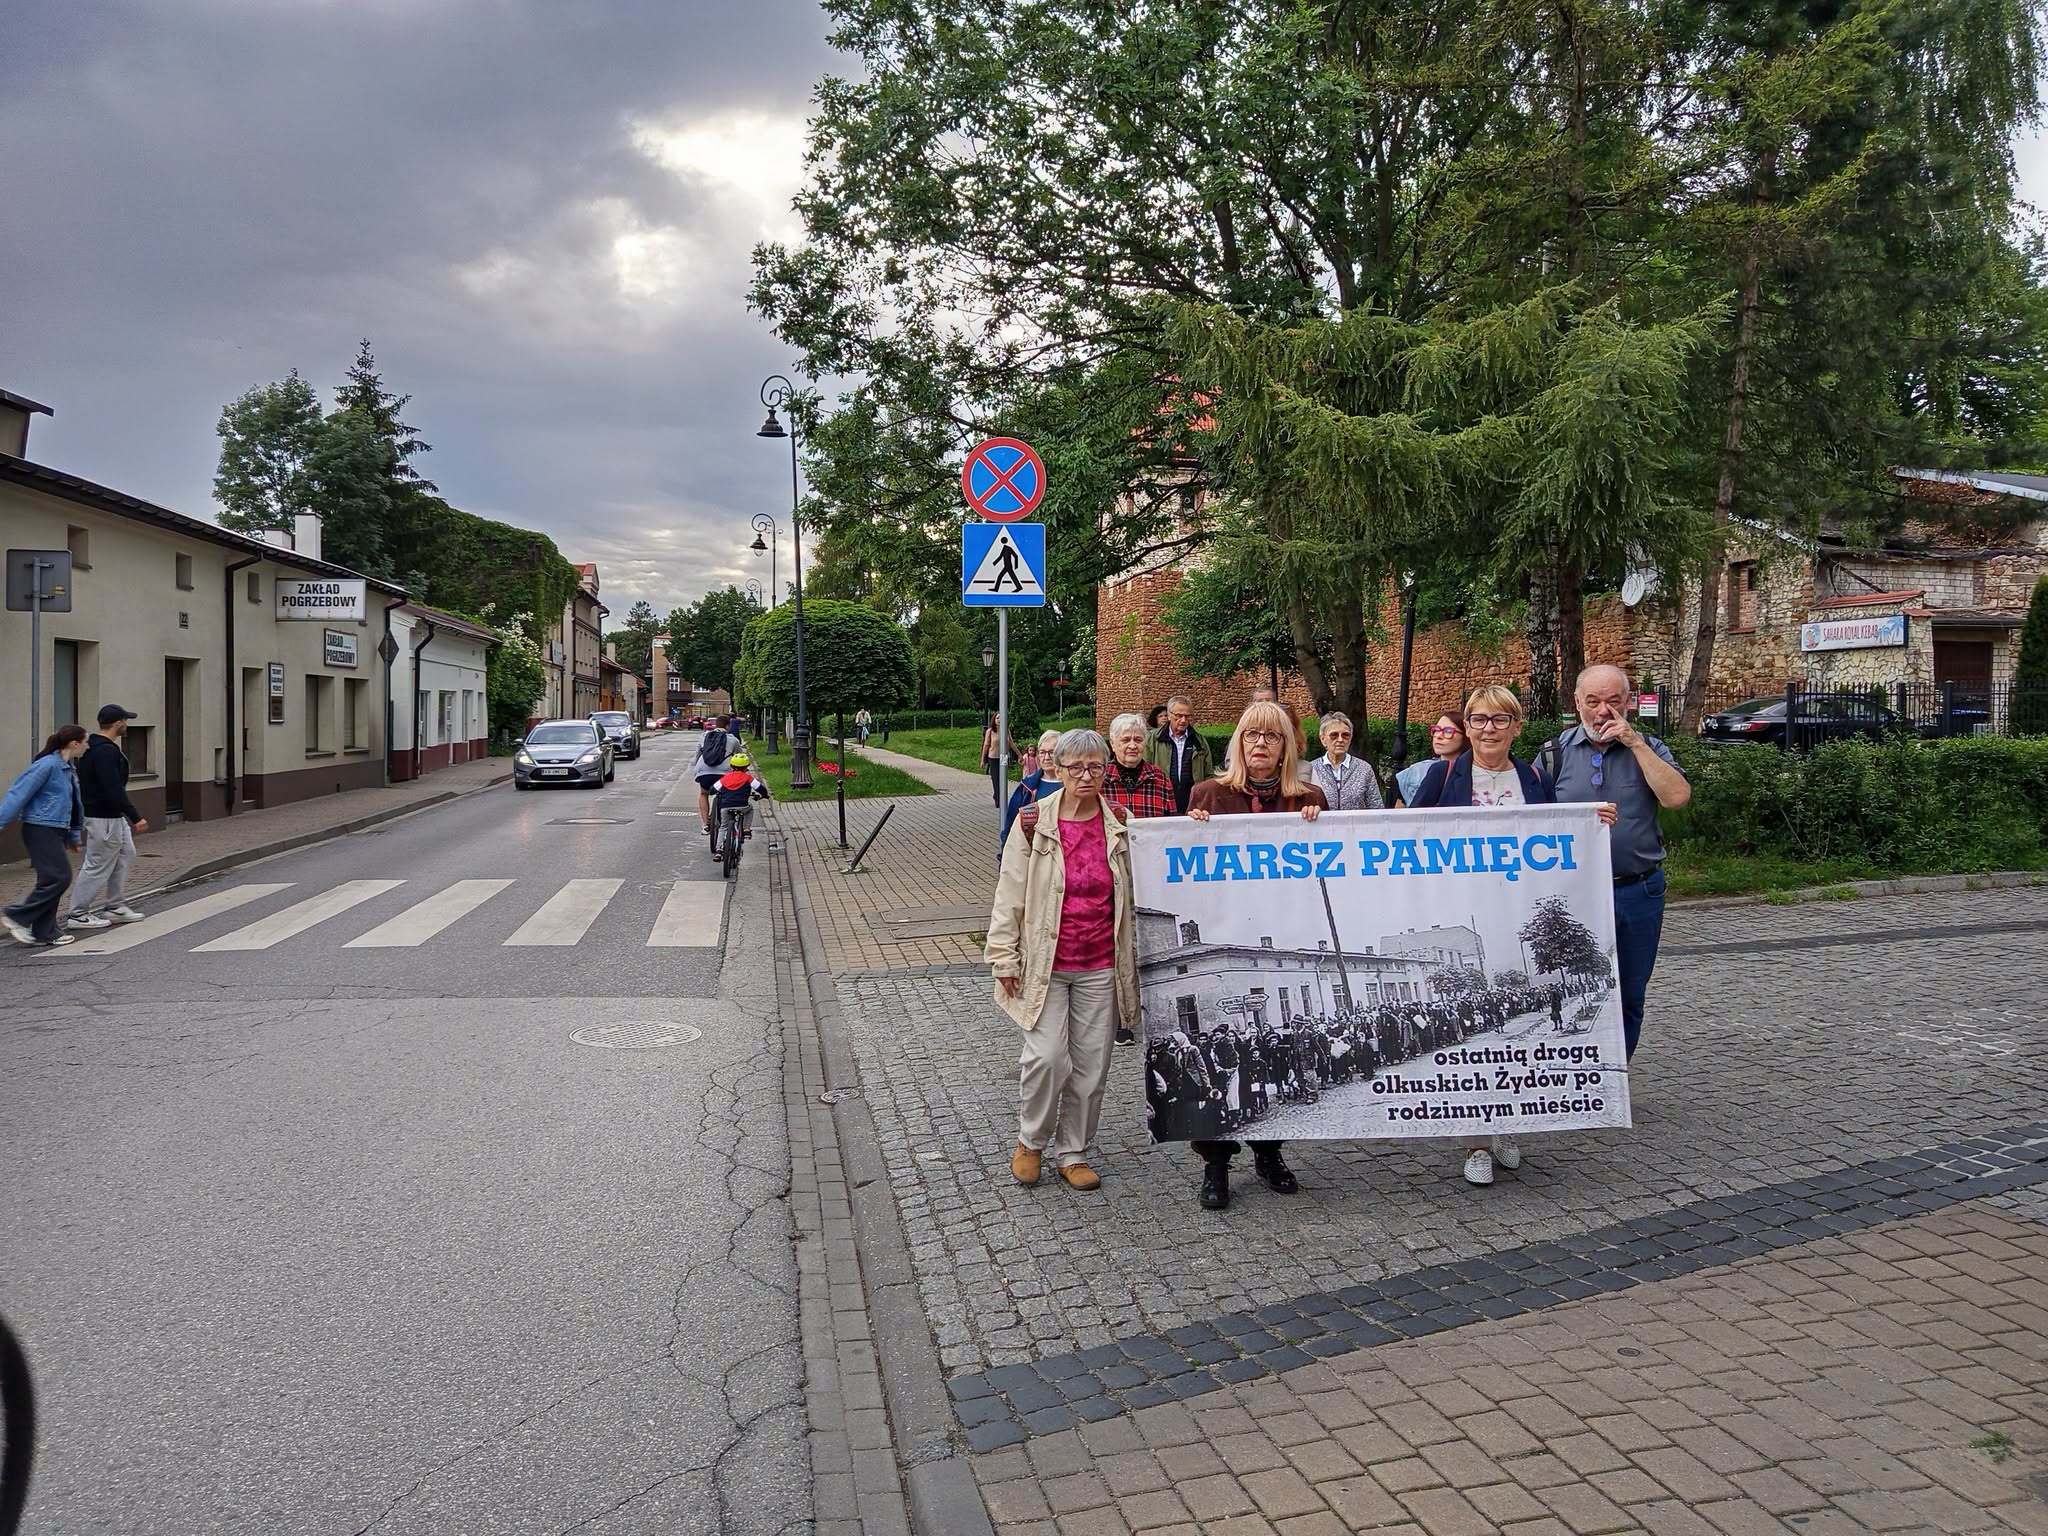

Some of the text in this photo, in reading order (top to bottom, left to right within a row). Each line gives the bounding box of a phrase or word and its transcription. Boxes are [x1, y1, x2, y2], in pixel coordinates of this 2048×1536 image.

[298, 584, 340, 594] ZAKŁAD
[281, 596, 357, 607] POGRZEBOWY
[1861, 624, 1879, 640] KEBAB
[1165, 834, 1577, 883] MARSZ PAMIĘCI
[1434, 1043, 1600, 1066] ostatnią drogą
[1372, 1066, 1601, 1095] olkuskich Żydów po
[1388, 1094, 1604, 1122] rodzinnym mieście
